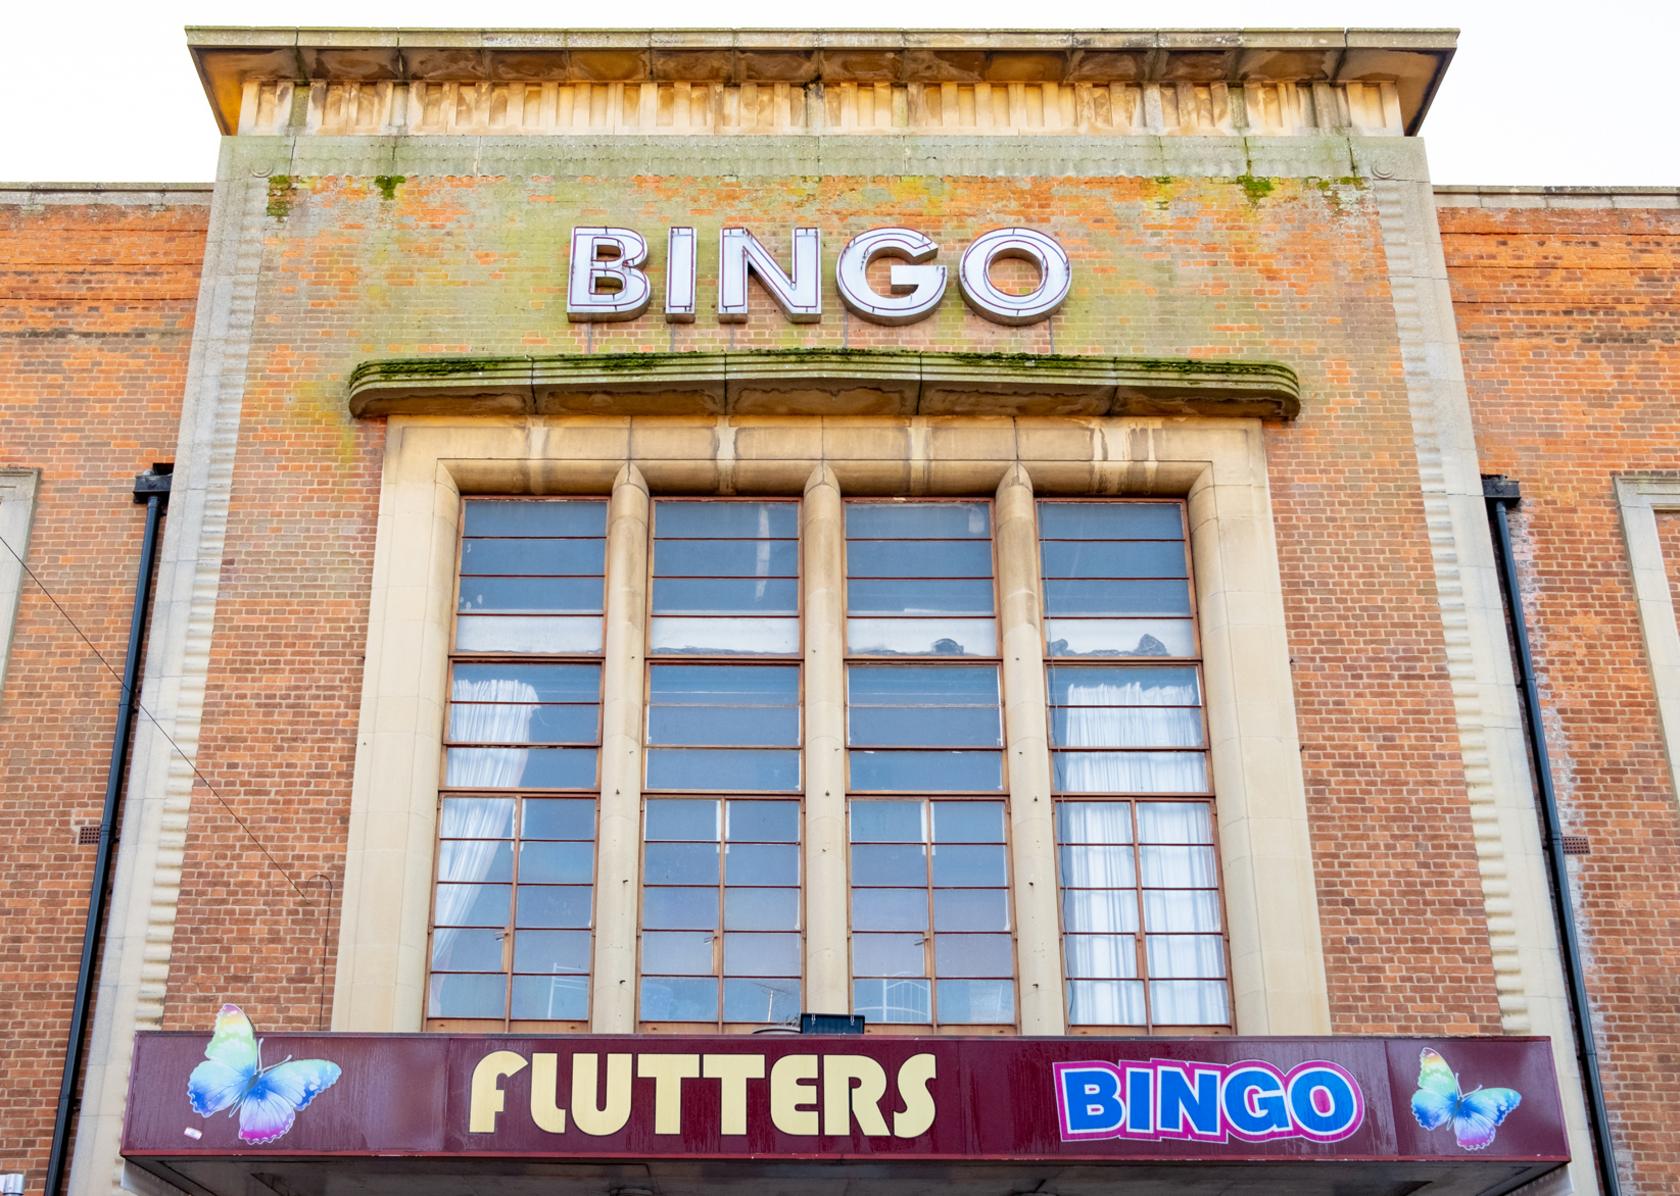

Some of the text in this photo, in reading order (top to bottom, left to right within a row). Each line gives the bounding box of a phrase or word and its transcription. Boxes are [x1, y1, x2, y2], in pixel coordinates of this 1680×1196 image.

[567, 226, 1072, 326] BINGO
[468, 1050, 1364, 1143] FLUTTERS BINGO
